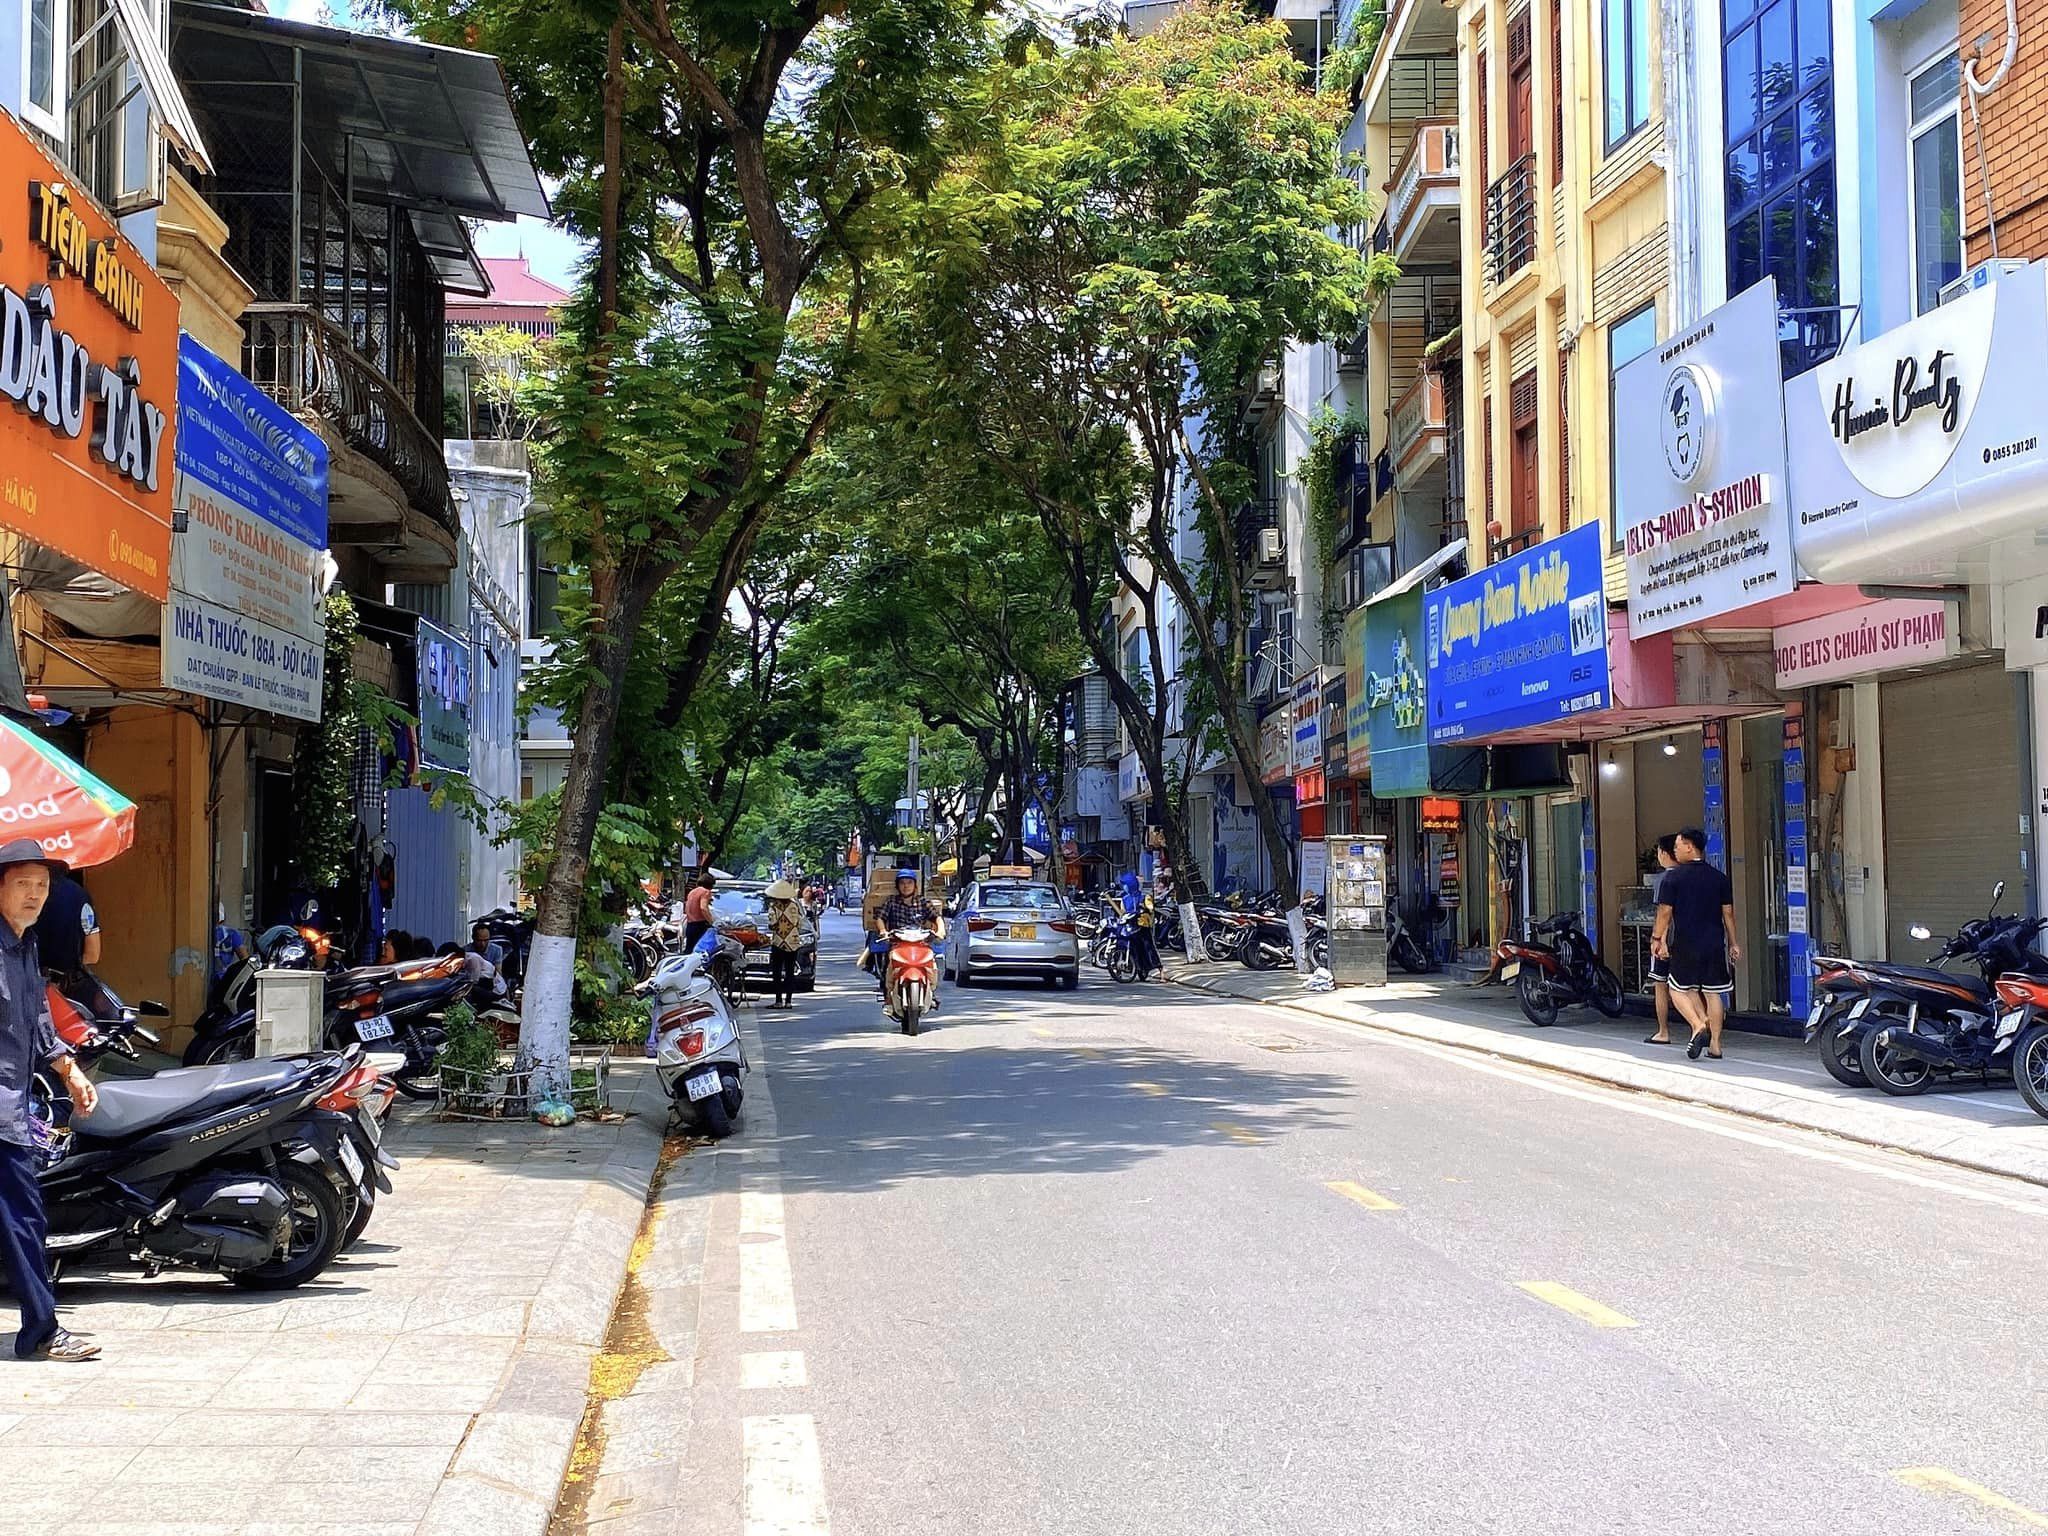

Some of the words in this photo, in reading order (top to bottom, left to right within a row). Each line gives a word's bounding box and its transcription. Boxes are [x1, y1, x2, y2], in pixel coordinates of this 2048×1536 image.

[39, 183, 88, 279] TIỆM
[94, 239, 144, 331] BÁNH
[0, 284, 89, 437] DÂU
[101, 355, 167, 492] TÂY
[1992, 444, 2011, 462] 0855
[188, 492, 233, 537] PHÒNG
[235, 516, 269, 557] KHÁM
[1626, 519, 1656, 557] IELTS
[1658, 492, 1708, 545] PANDA'S
[1711, 473, 1762, 522] STATION
[1516, 549, 1571, 621] Mobile
[175, 605, 204, 645] NHÀ
[207, 616, 249, 658] THUỐC
[252, 635, 276, 668] 186A
[283, 641, 301, 681] ĐỘI
[301, 645, 320, 682] CẤN
[187, 656, 203, 682] ĐẠT
[202, 657, 226, 682] CHUẨN
[1775, 645, 1798, 678] HỌC
[1799, 637, 1831, 670] IELTS
[1833, 615, 1878, 662] CHUẨN
[1881, 617, 1901, 652] SƯ
[1903, 610, 1945, 650] PHẠM
